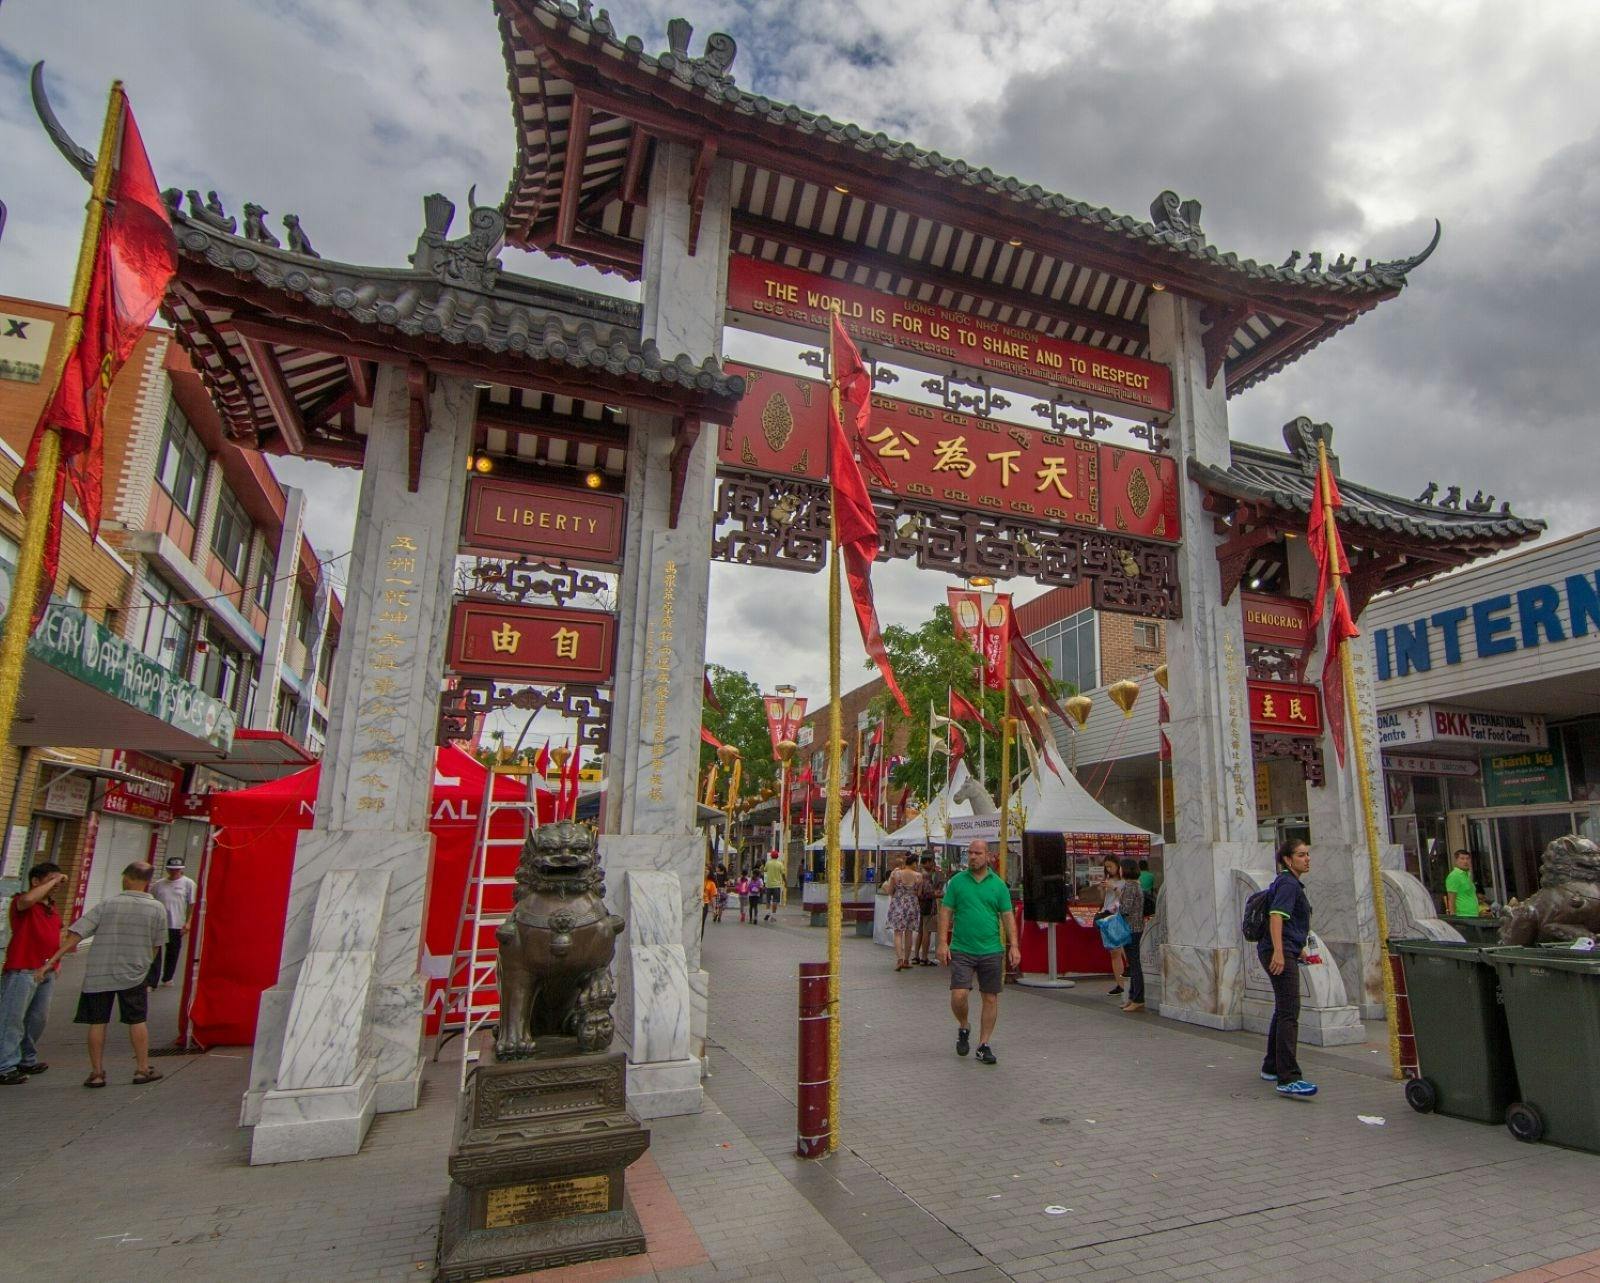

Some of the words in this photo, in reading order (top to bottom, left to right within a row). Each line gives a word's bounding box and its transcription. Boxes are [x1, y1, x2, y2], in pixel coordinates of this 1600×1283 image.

[0, 318, 31, 340] X
[765, 280, 798, 303] THE
[870, 307, 886, 324] IS
[892, 313, 922, 335] FOR
[930, 322, 950, 341] US
[957, 329, 977, 347] TO
[983, 336, 1029, 361] SHARE
[1036, 349, 1062, 369] AND
[1069, 357, 1087, 374] TO
[1092, 362, 1150, 390] RESPECT
[496, 506, 599, 535] LIBERTY
[1247, 610, 1303, 630] DEMOCRACY
[1374, 568, 1600, 681] INTERN
[36, 604, 86, 660] ERY
[86, 632, 121, 681] DAY
[1376, 711, 1401, 730] ONAL
[1435, 711, 1469, 736] BKK
[1471, 726, 1486, 740] Fast
[1488, 728, 1505, 741] Food
[299, 799, 316, 816] N
[429, 799, 477, 820] AL
[75, 857, 92, 920] CHEMI
